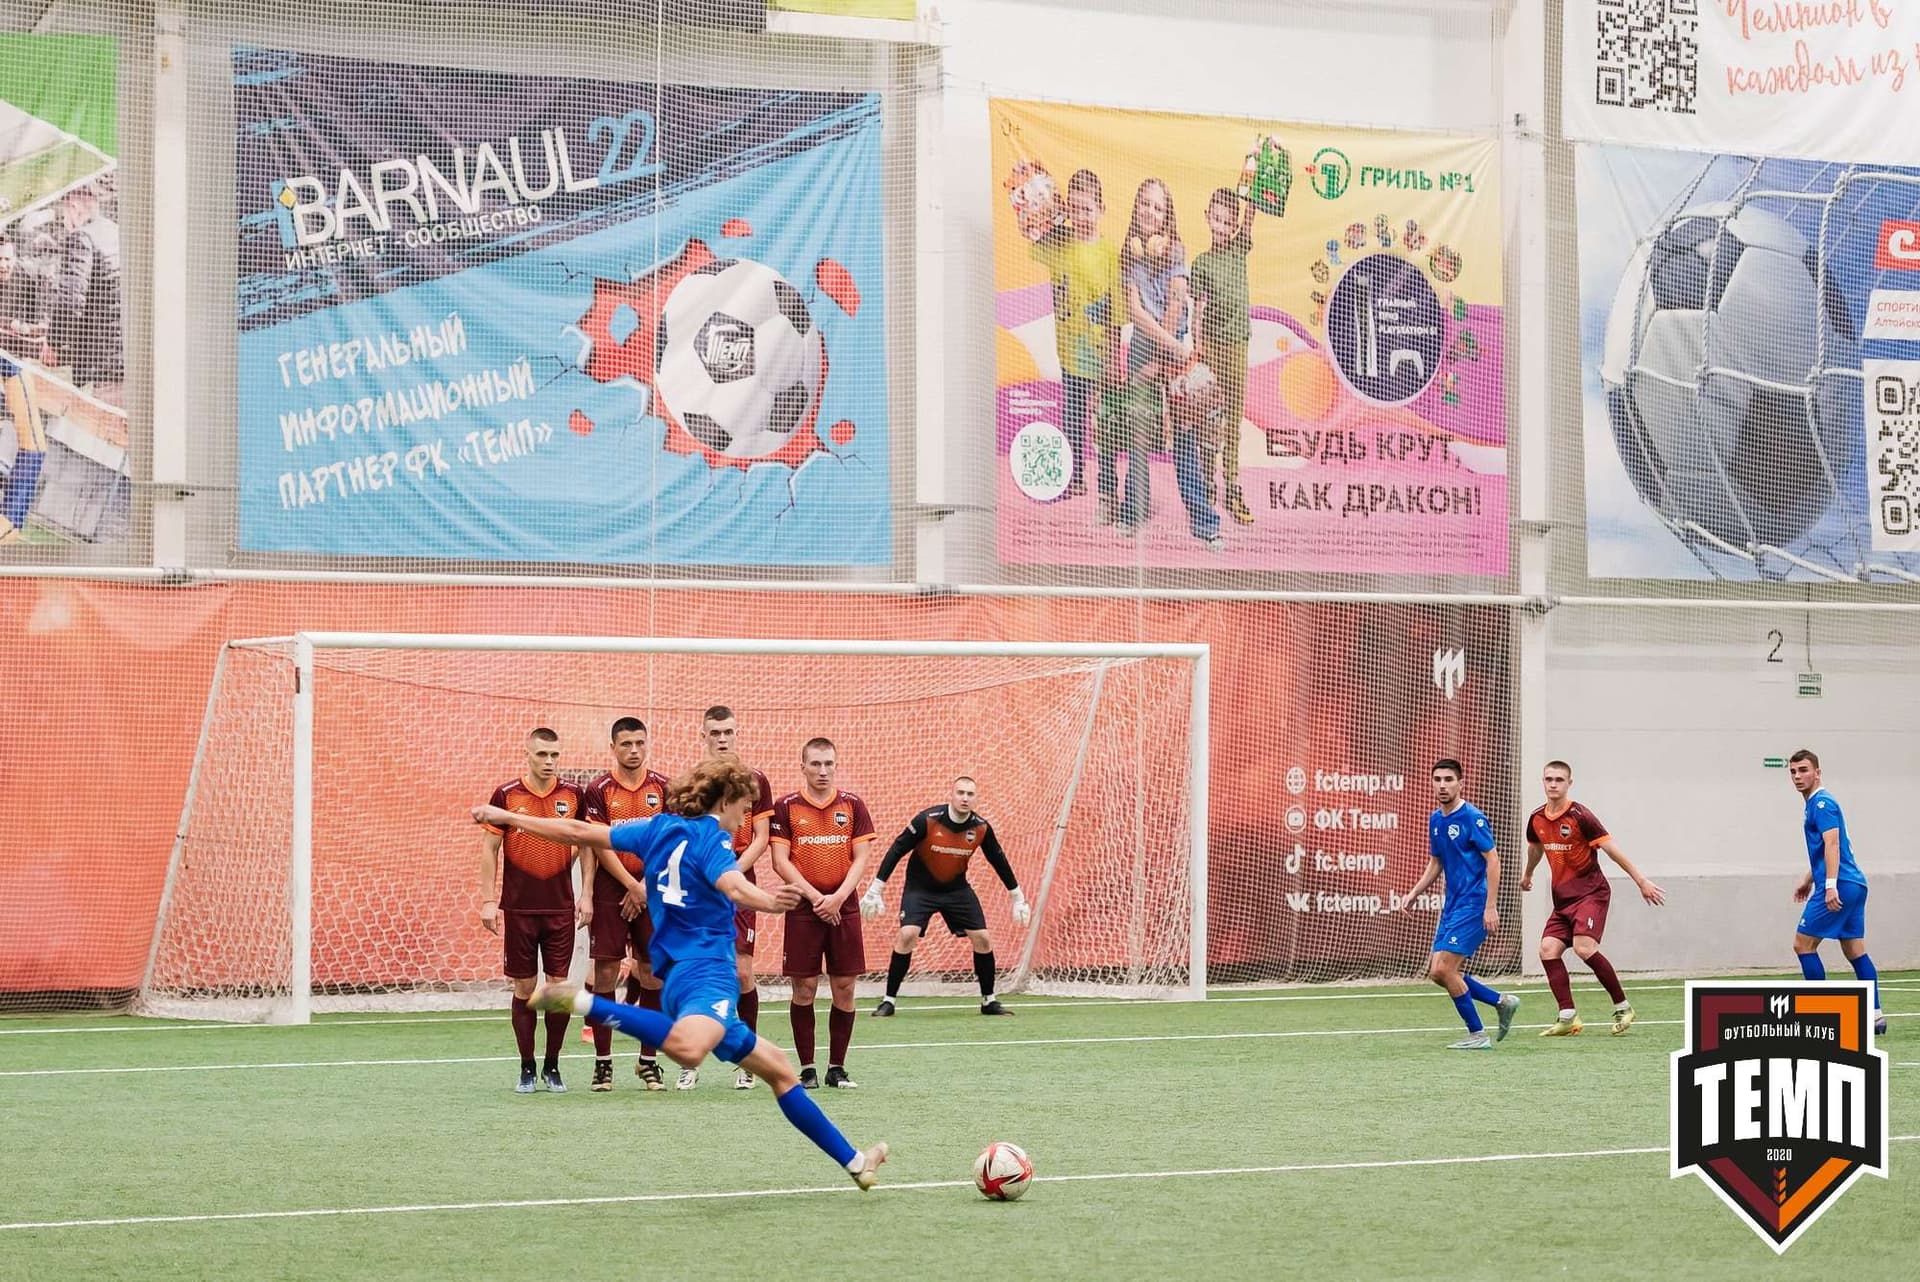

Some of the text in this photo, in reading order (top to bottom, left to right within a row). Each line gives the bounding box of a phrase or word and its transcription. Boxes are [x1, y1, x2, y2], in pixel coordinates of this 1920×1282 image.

[1727, 40, 1866, 96] каждом
[1871, 49, 1910, 92] из
[1360, 165, 1474, 193] ГРИЛЬ №1
[285, 239, 387, 270] ИНТЕРНЕТ
[404, 205, 543, 248] СООБЩЕСТВО
[278, 311, 467, 388] ГЕНЕРАЛЬНЫЙ
[279, 355, 536, 452] ИНФОРМАЦИОННЫЙ
[278, 418, 553, 510] ПАРТНЕР ФК «ТЕМП»
[1265, 428, 1461, 467] БУДЬ КРУТ,
[1269, 481, 1482, 518] КАК ДРАКОН!
[1767, 629, 1783, 662] 2
[1314, 769, 1404, 795] fctemp.ru
[1314, 808, 1398, 831] ФК Темп
[657, 840, 688, 908] 4
[1315, 850, 1386, 875] fc.temp
[1587, 917, 1594, 930] 4
[711, 1000, 730, 1019] 4
